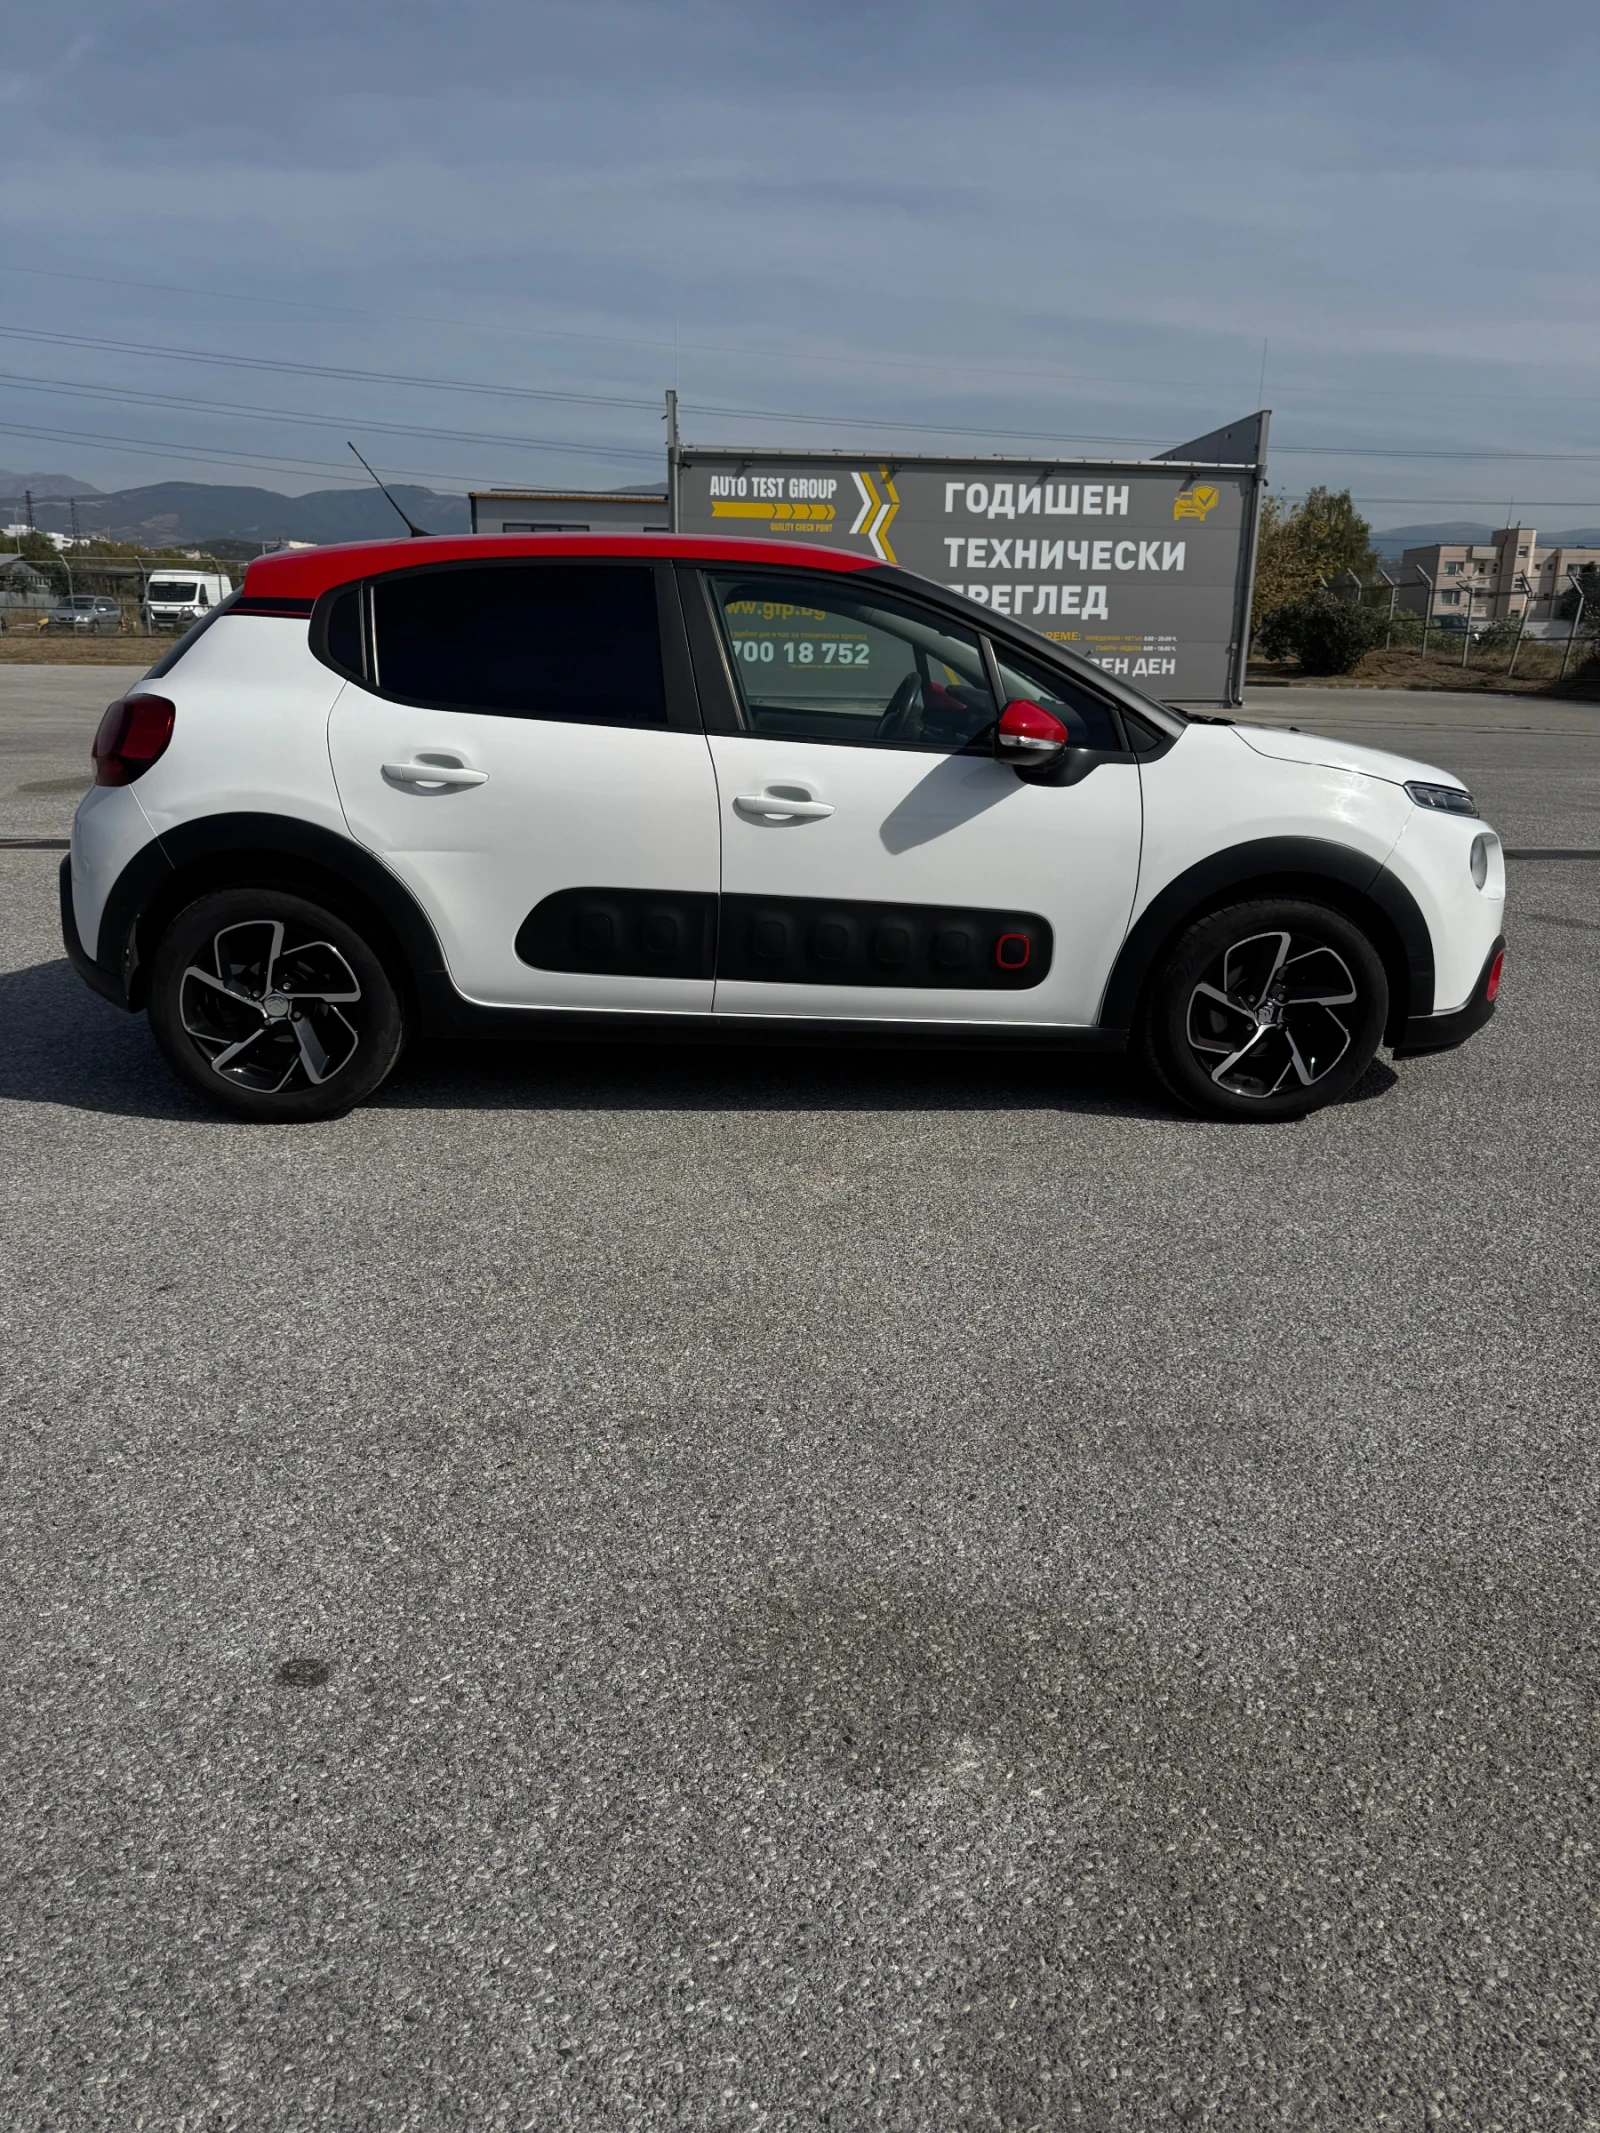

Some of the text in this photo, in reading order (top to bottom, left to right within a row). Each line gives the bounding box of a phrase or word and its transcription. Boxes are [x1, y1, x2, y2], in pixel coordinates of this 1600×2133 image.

[710, 476, 837, 499] AUTO TEST GROUP
[944, 482, 1130, 520] ГОДИШЕН
[770, 522, 833, 533] QUALITY CHECK POINT
[944, 537, 1187, 571] ТЕХНИЧЕСКИ
[783, 641, 814, 664] 18
[821, 642, 870, 665] 752
[1132, 658, 1176, 677] ДЕН
